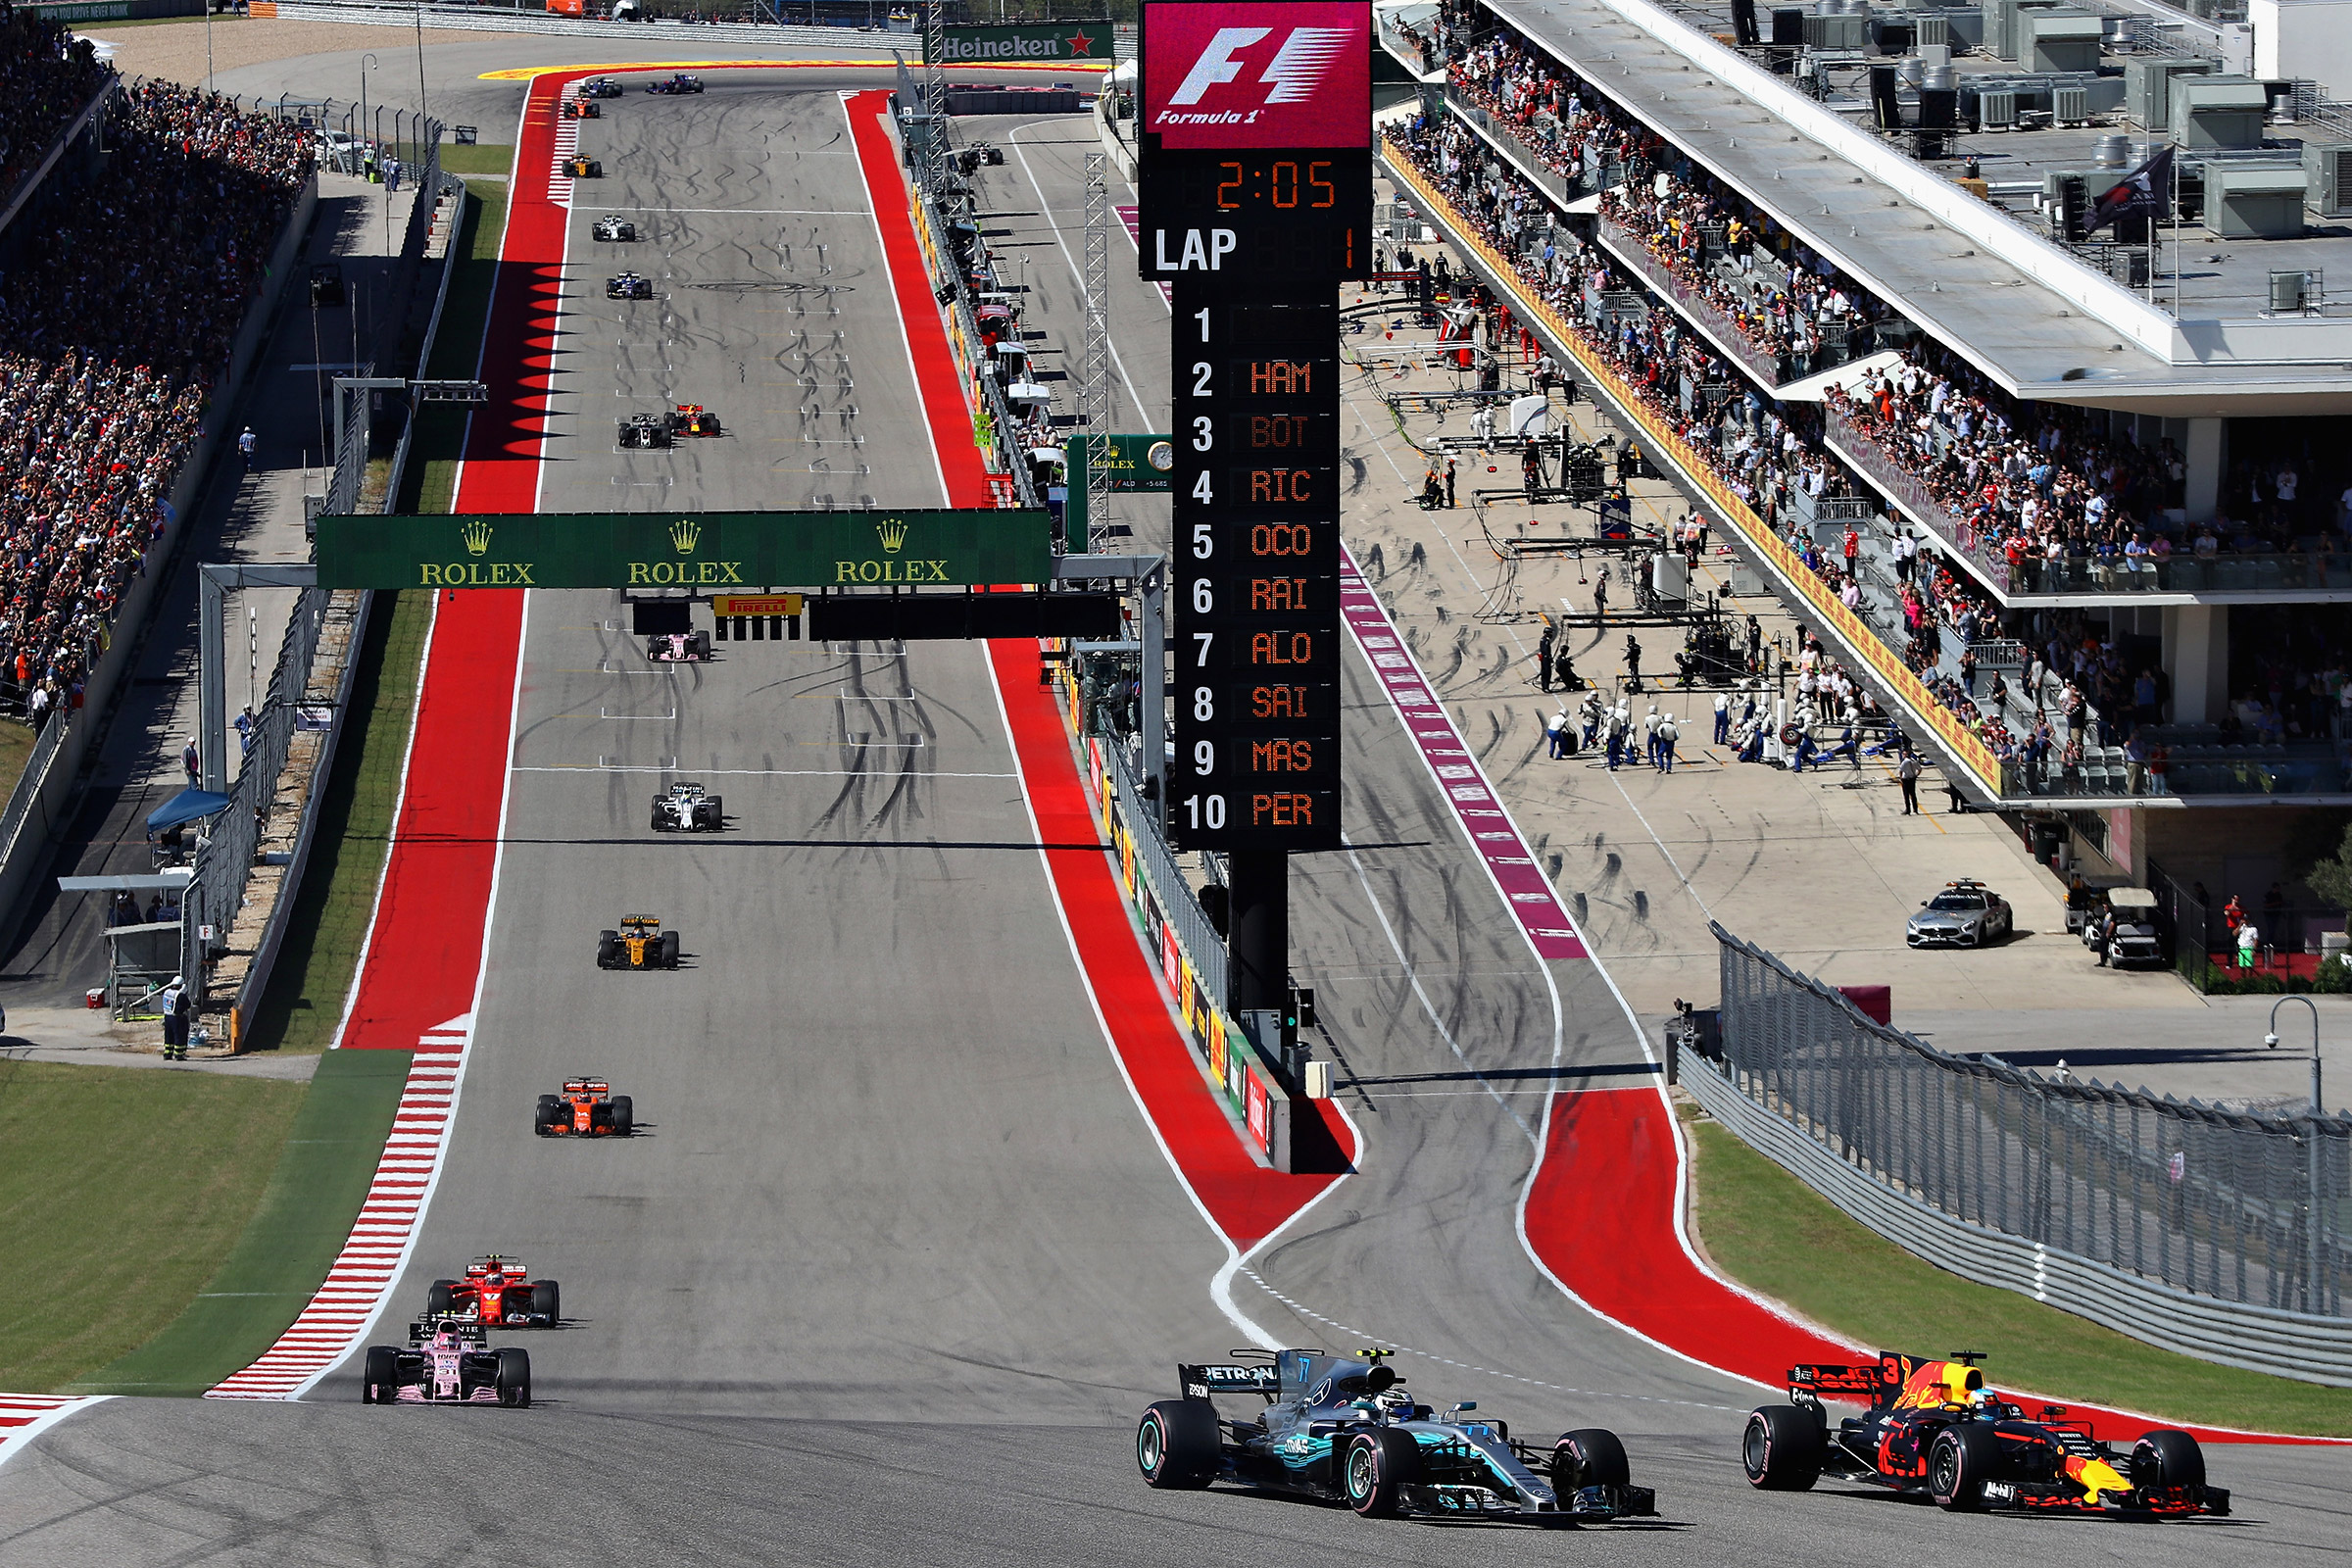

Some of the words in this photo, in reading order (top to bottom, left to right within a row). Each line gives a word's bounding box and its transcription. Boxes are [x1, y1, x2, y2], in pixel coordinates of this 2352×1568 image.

[59, 7, 72, 19] YOU
[73, 6, 89, 19] DRIVE
[90, 5, 108, 18] NEVER
[943, 35, 1059, 58] Heineken
[1168, 27, 1359, 105] F1
[1154, 110, 1241, 124] Formula
[1244, 110, 1258, 123] 1
[1217, 162, 1334, 208] 2:05
[1155, 228, 1237, 270] LAP
[1347, 227, 1352, 269] 1
[1194, 307, 1209, 342] 1
[1192, 362, 1212, 397] 2
[1251, 362, 1310, 393] HAM
[1193, 416, 1213, 451] 3
[1251, 416, 1308, 447] BOT
[1094, 460, 1135, 468] ROLEX
[1192, 470, 1213, 504] 4
[1251, 470, 1311, 501] RIC
[1193, 524, 1213, 559] 5
[1251, 524, 1311, 556] OCO
[419, 564, 535, 585] ROLEX
[627, 562, 743, 583] ROLEX
[835, 560, 950, 582] ROLEX
[728, 599, 787, 612] PIRELLI
[1193, 578, 1213, 613] 6
[1251, 578, 1307, 610] RAI
[1193, 633, 1213, 666] 7
[1251, 632, 1311, 663] ALO
[1194, 686, 1213, 721] 8
[1252, 686, 1307, 717] SAI
[1194, 740, 1214, 775] 9
[1252, 740, 1311, 771] MAS
[1184, 794, 1225, 829] 10
[1252, 794, 1312, 825] PER
[1883, 1357, 1899, 1384] 3
